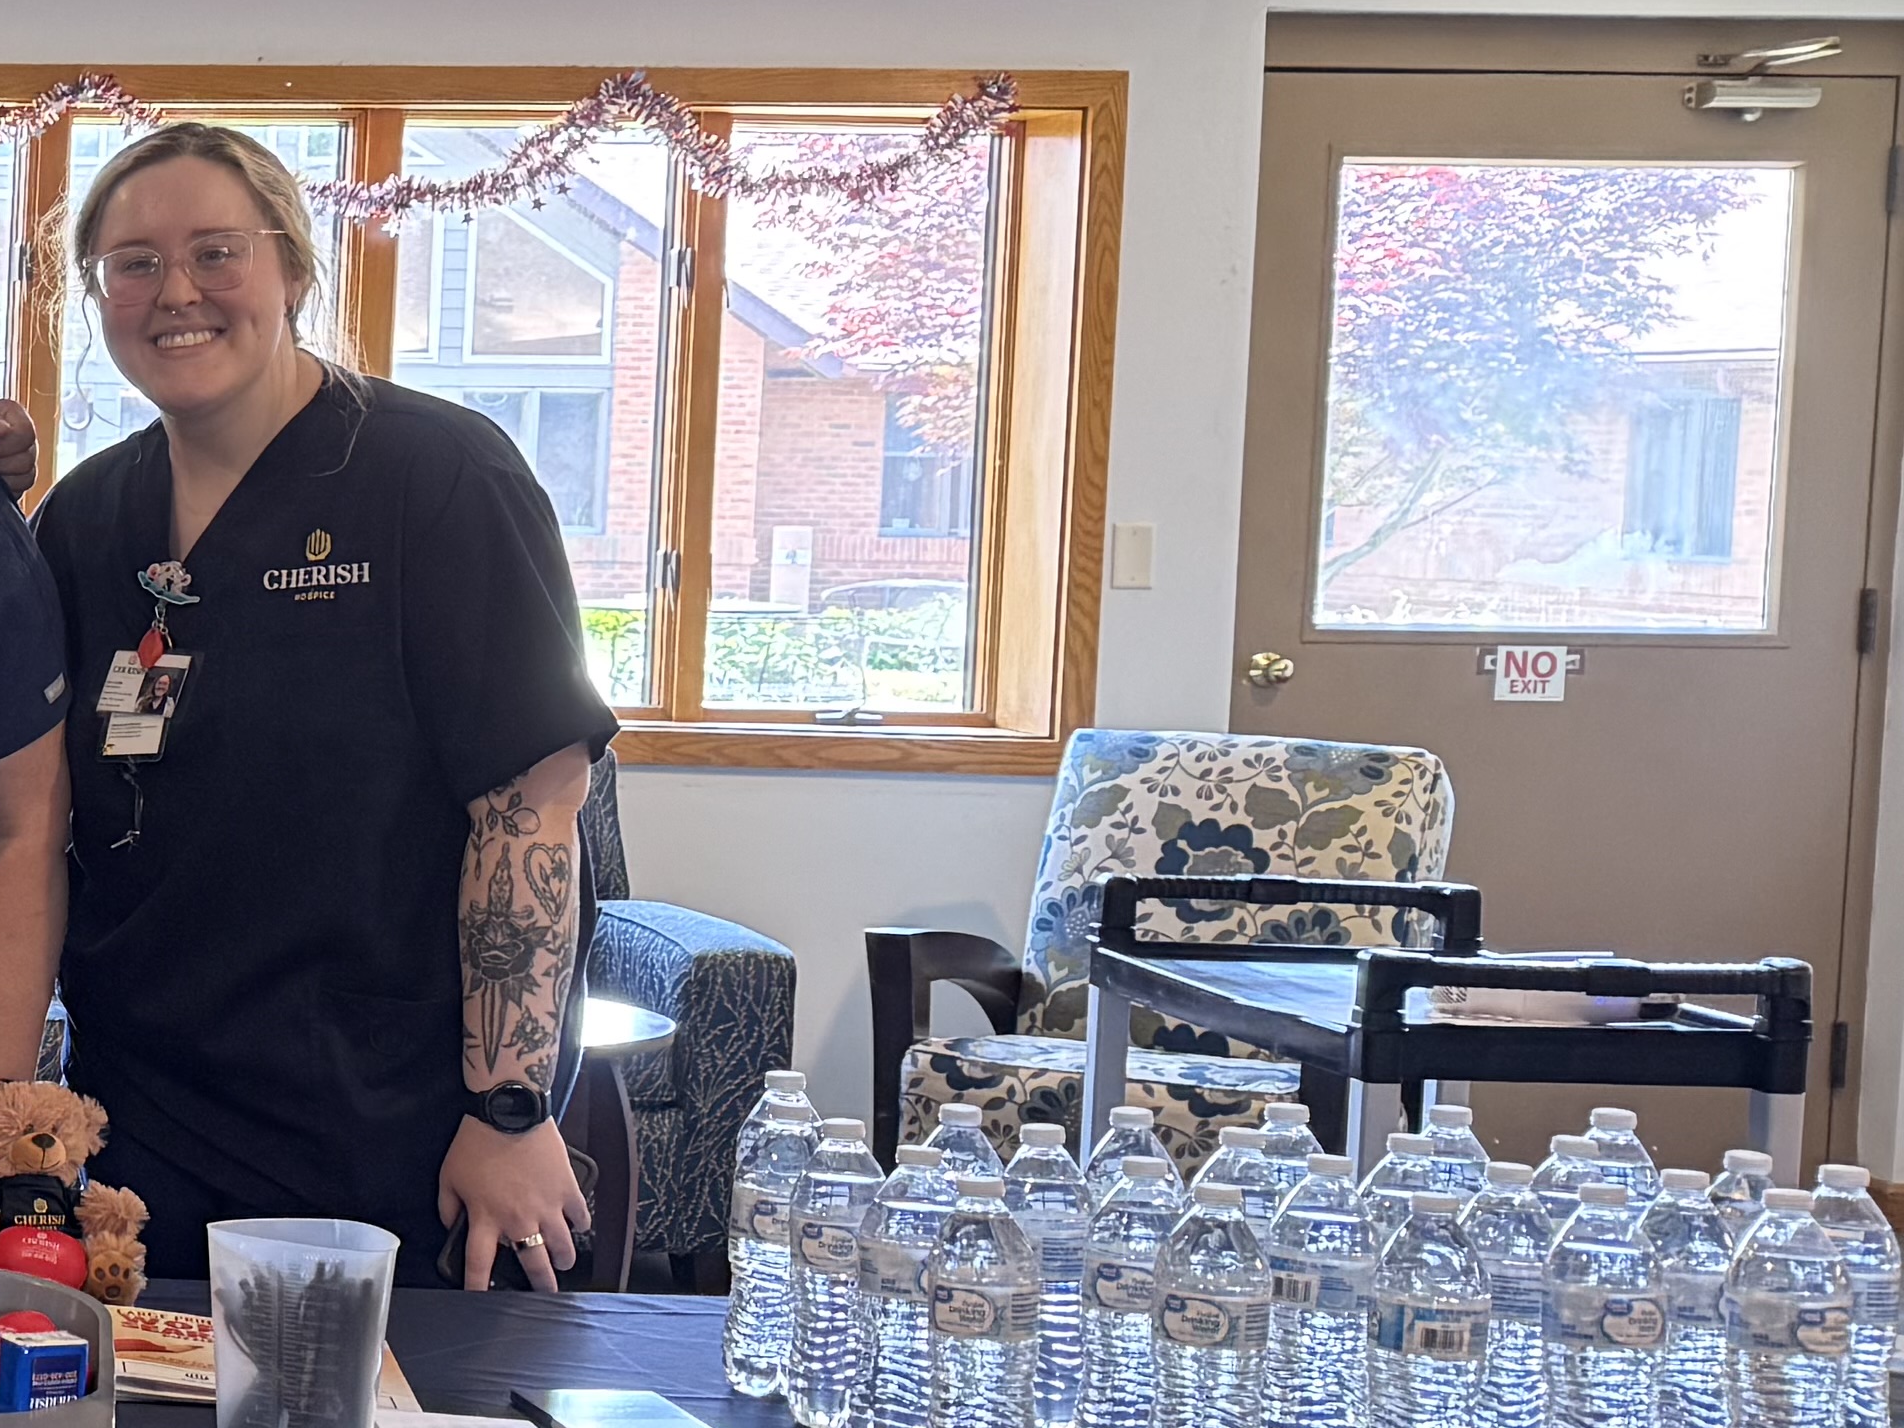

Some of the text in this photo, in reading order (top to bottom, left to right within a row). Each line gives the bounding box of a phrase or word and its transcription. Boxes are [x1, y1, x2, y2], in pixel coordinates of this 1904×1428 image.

[263, 562, 370, 590] CHERISH
[1504, 650, 1558, 679] NO
[1509, 679, 1551, 694] EXIT
